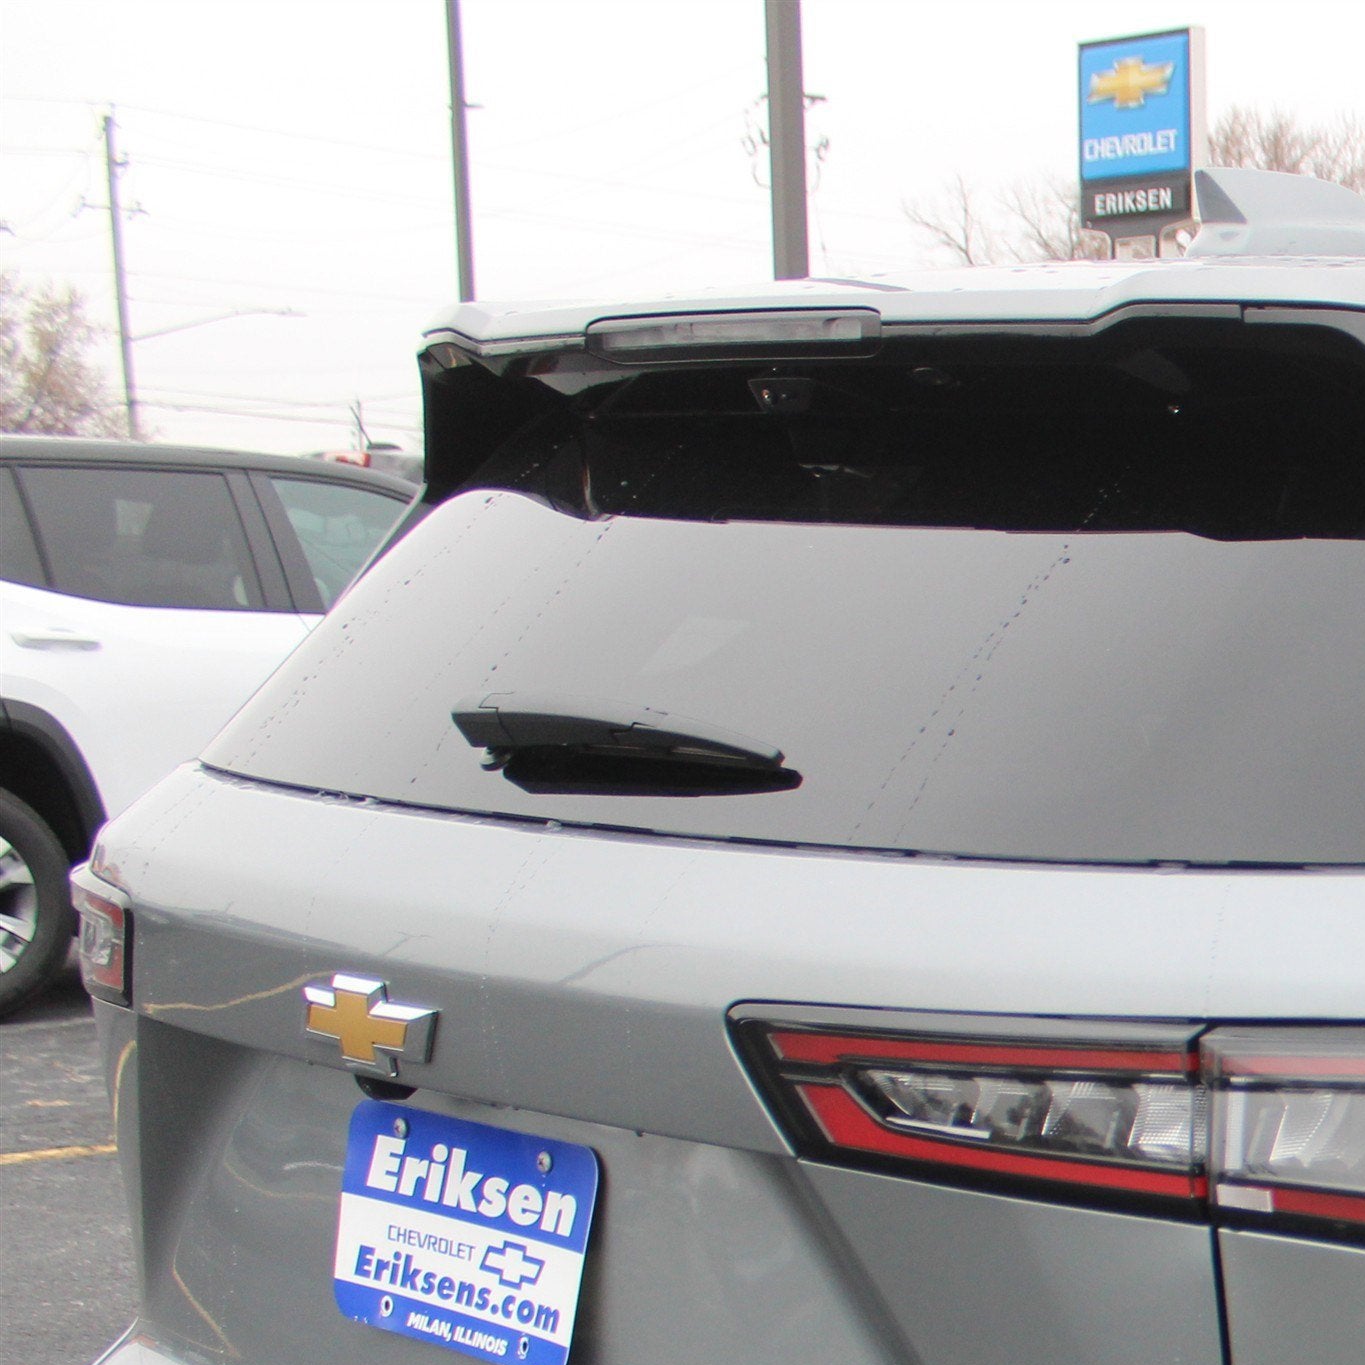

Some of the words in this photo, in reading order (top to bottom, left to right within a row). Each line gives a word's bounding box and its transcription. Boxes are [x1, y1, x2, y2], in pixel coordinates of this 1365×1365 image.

[1084, 129, 1178, 162] CHEVROLET
[1094, 187, 1173, 216] ERIKSEN
[365, 1133, 578, 1238] Eriksen
[387, 1224, 477, 1262] CHEVROLET
[354, 1245, 560, 1335] Eriksens.com
[406, 1311, 453, 1342] MILAN,
[453, 1326, 508, 1357] ILLINOIS
